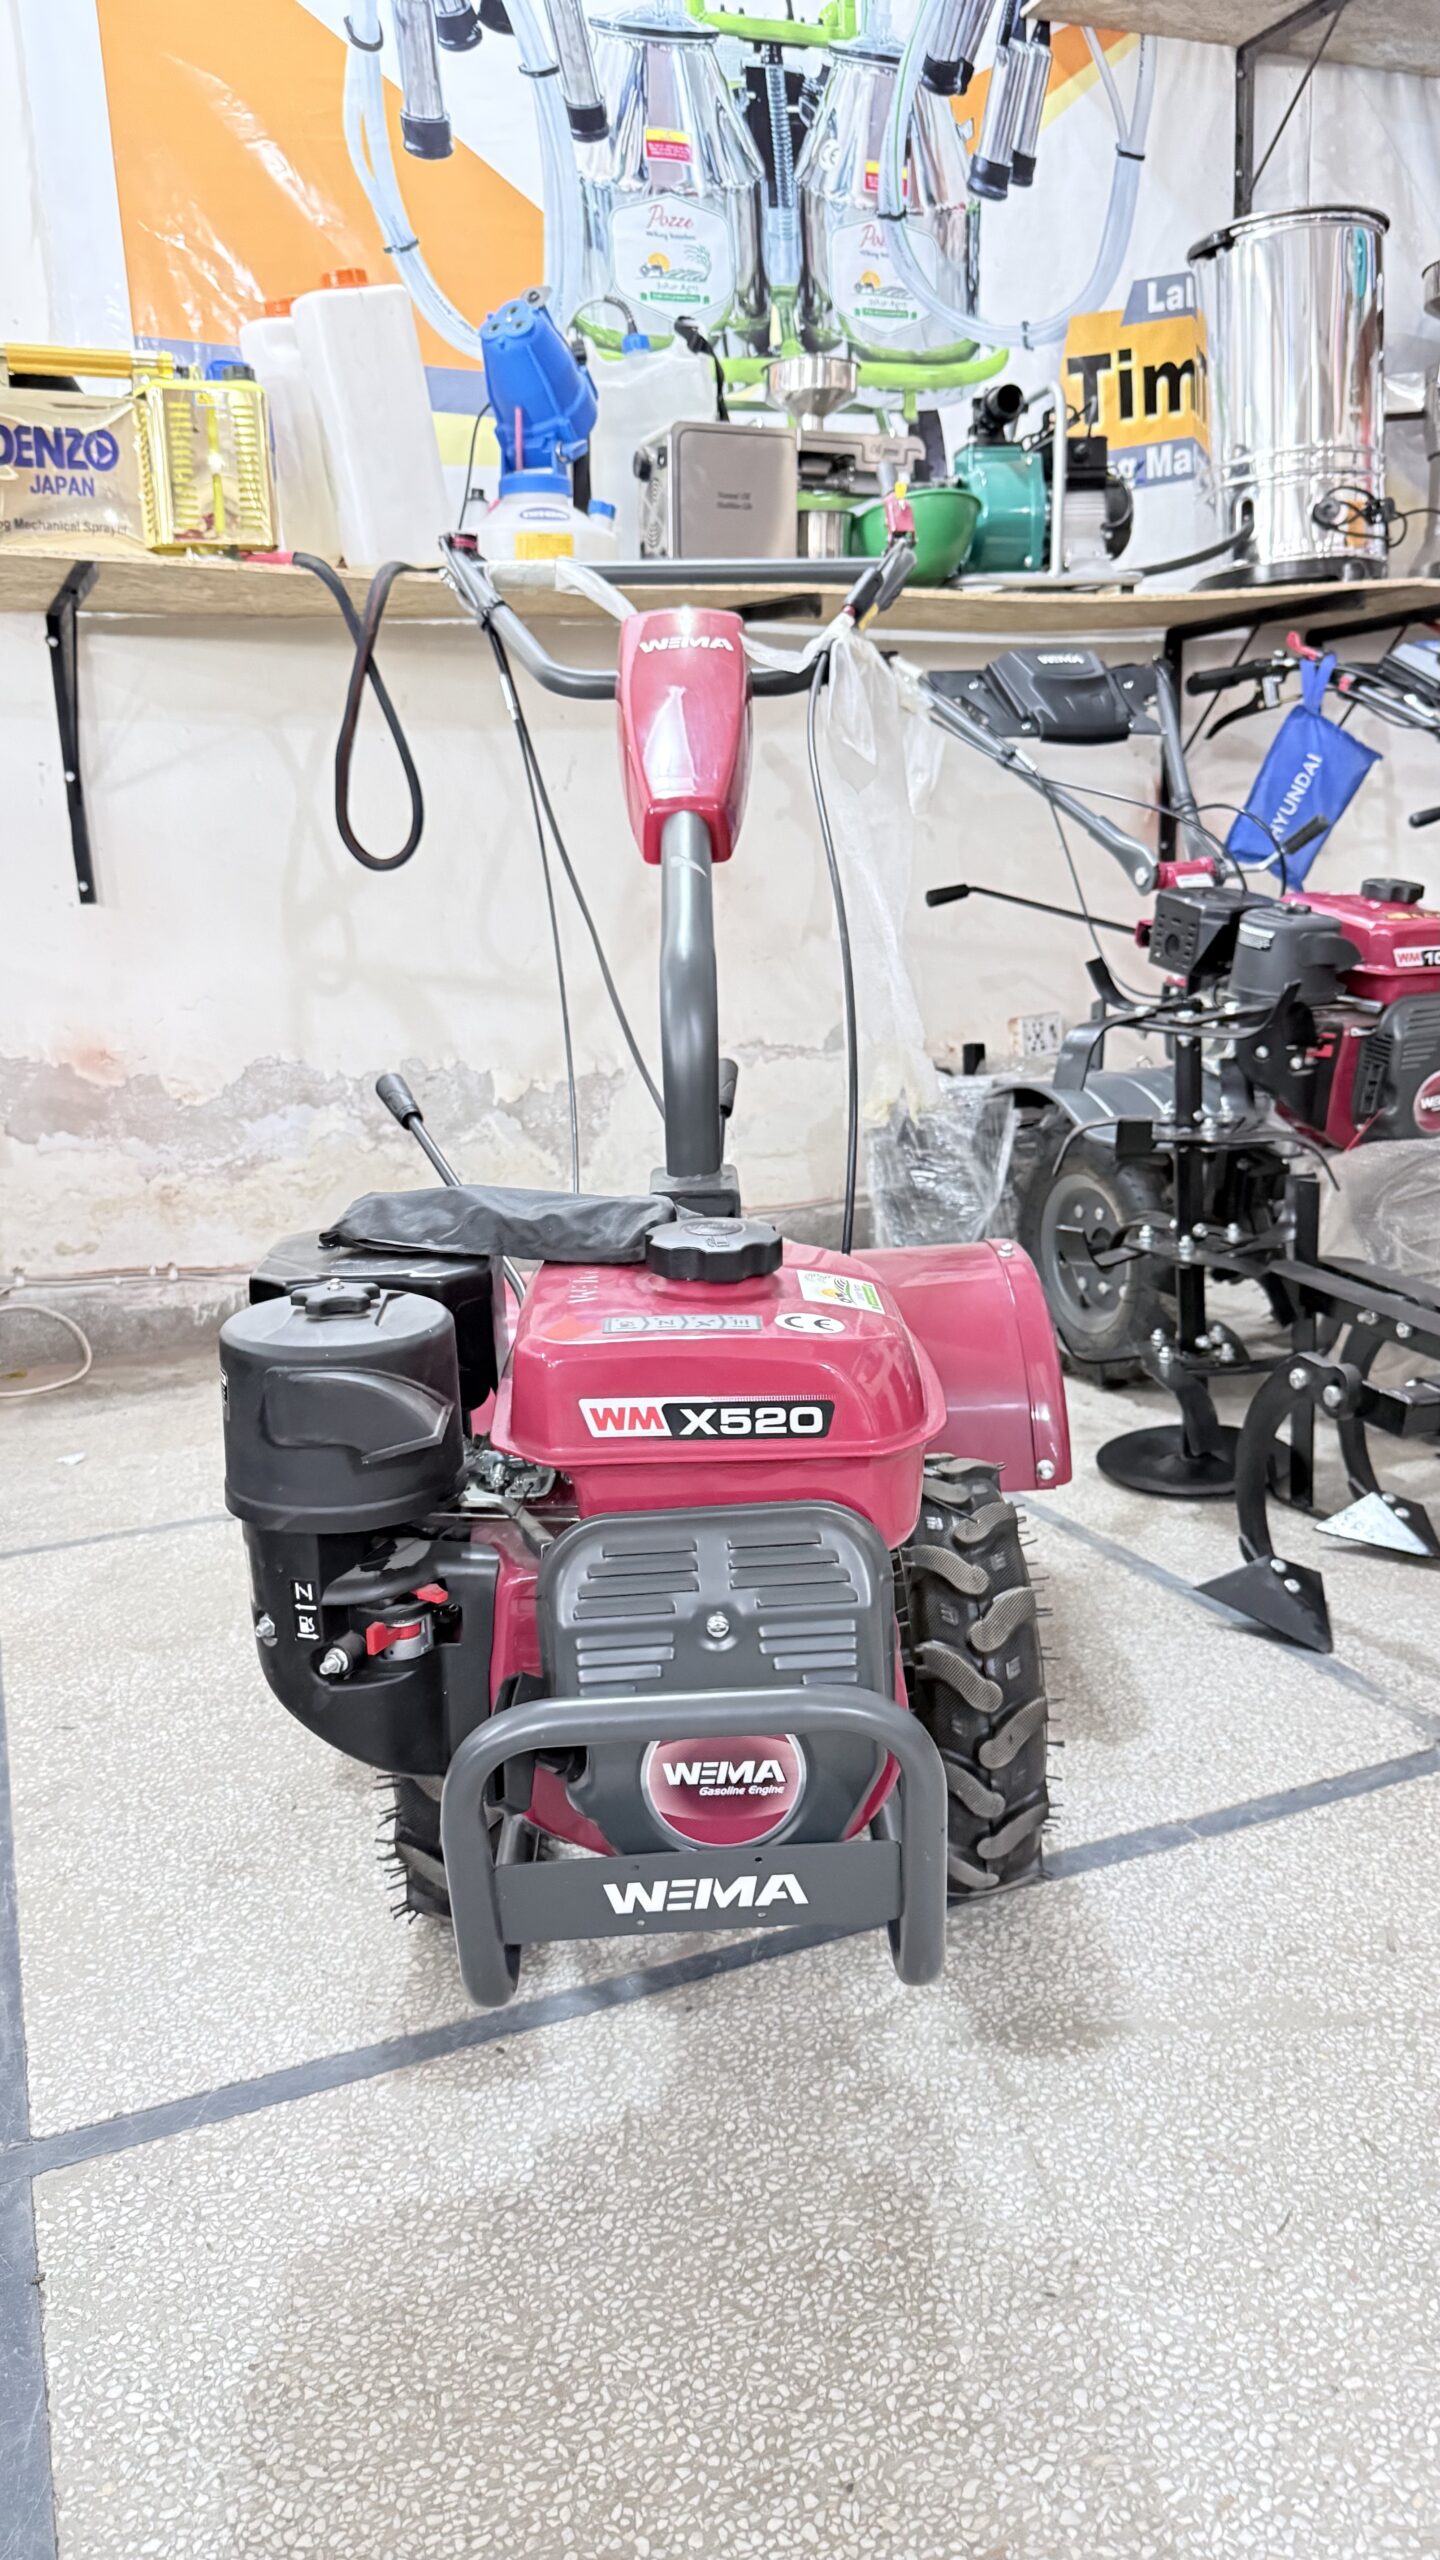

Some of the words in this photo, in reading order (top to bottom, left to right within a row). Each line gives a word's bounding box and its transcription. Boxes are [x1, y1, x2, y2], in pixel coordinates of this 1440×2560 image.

[29, 474, 95, 497] JAPAN
[13, 518, 80, 532] Mechanical
[639, 635, 734, 654] WEIMA
[1270, 752, 1322, 842] HYUNDAI
[589, 1406, 664, 1431] WM
[679, 1406, 823, 1435] X520
[662, 1760, 786, 1786] WEIMA
[699, 1785, 746, 1796] Gasoline
[748, 1784, 785, 1796] Engine
[602, 1873, 809, 1915] WEIMA
